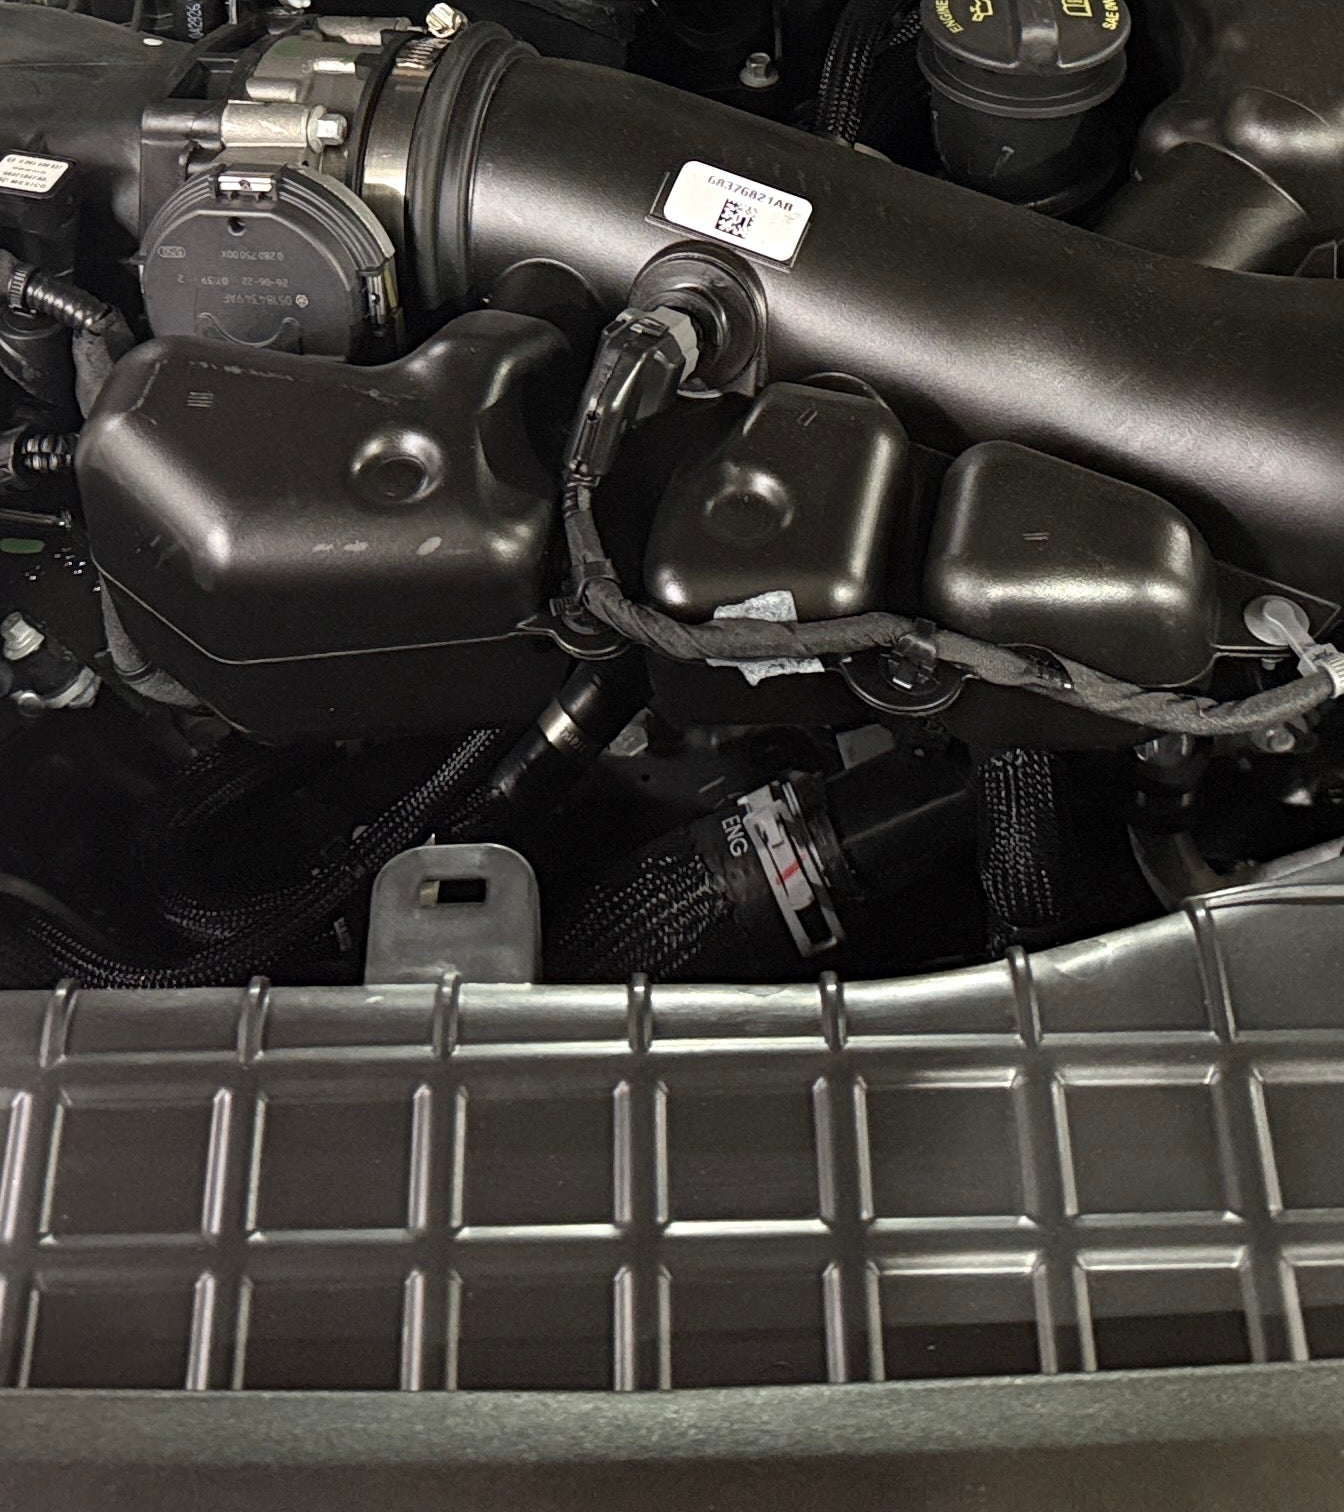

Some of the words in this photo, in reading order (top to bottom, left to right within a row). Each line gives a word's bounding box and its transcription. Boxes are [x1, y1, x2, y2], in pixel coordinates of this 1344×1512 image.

[935, 0, 965, 34] ENGINE
[1102, 11, 1120, 31] SAE
[707, 174, 794, 212] 68376821AB
[721, 815, 748, 857] ENG
